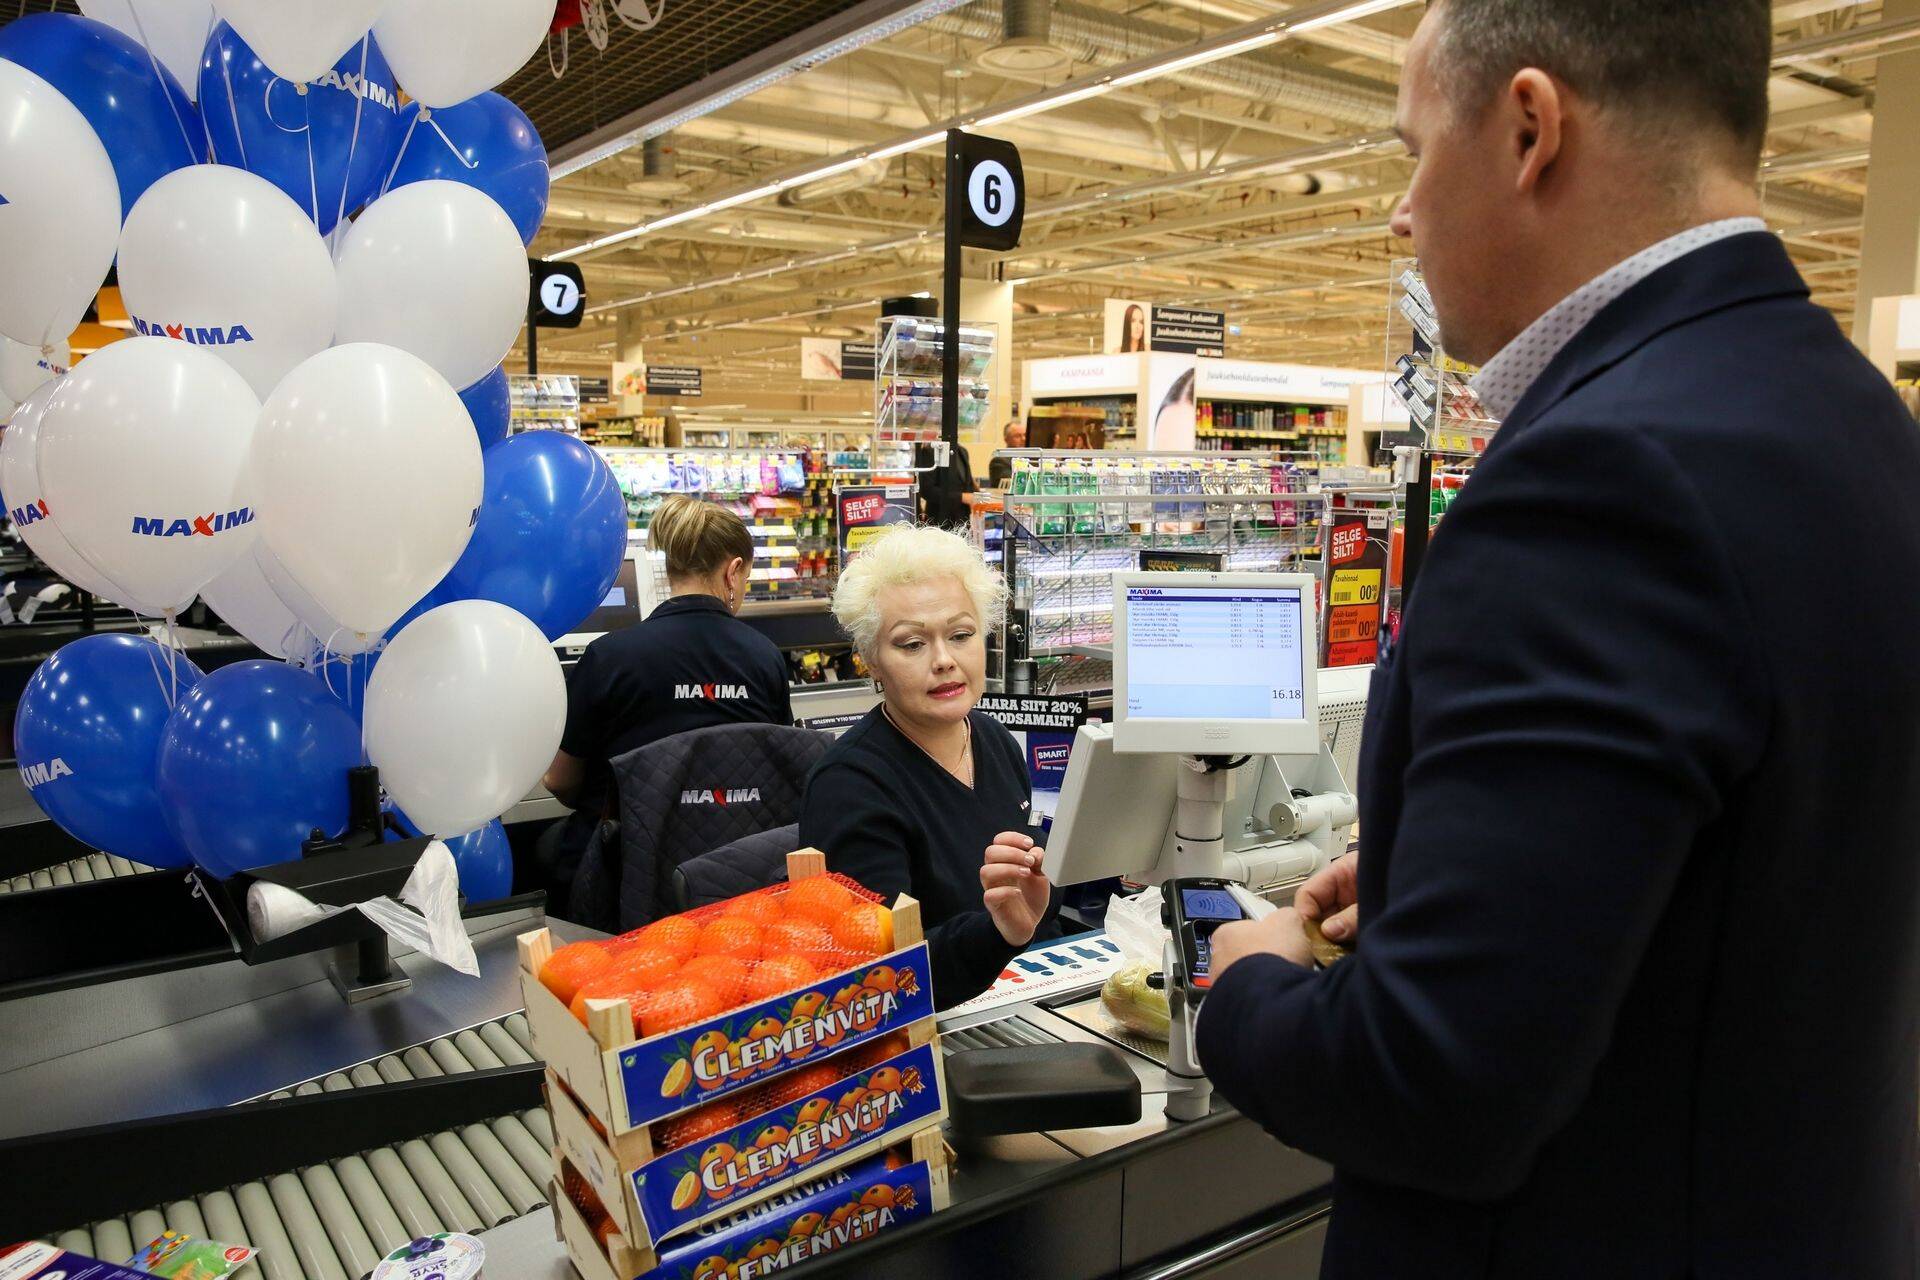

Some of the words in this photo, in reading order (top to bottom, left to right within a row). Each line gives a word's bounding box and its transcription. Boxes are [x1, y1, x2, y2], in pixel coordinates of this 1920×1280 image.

[309, 70, 397, 115] AXIMA
[983, 174, 1001, 215] 6
[553, 284, 569, 308] 7
[132, 315, 254, 345] MAXIMA
[846, 498, 879, 512] SELGE
[847, 509, 872, 521] SILT!
[1333, 527, 1362, 546] SELGE
[1333, 543, 1355, 560] SILT!
[674, 683, 749, 700] MAXIMA
[1272, 689, 1302, 699] 16.18
[1020, 699, 1049, 713] SIIT
[1051, 701, 1082, 714] 20%
[981, 711, 1075, 728] OODSAMALT!
[1037, 749, 1067, 760] SMART
[680, 787, 762, 806] MAXIMA
[412, 1262, 447, 1278] SKYR
